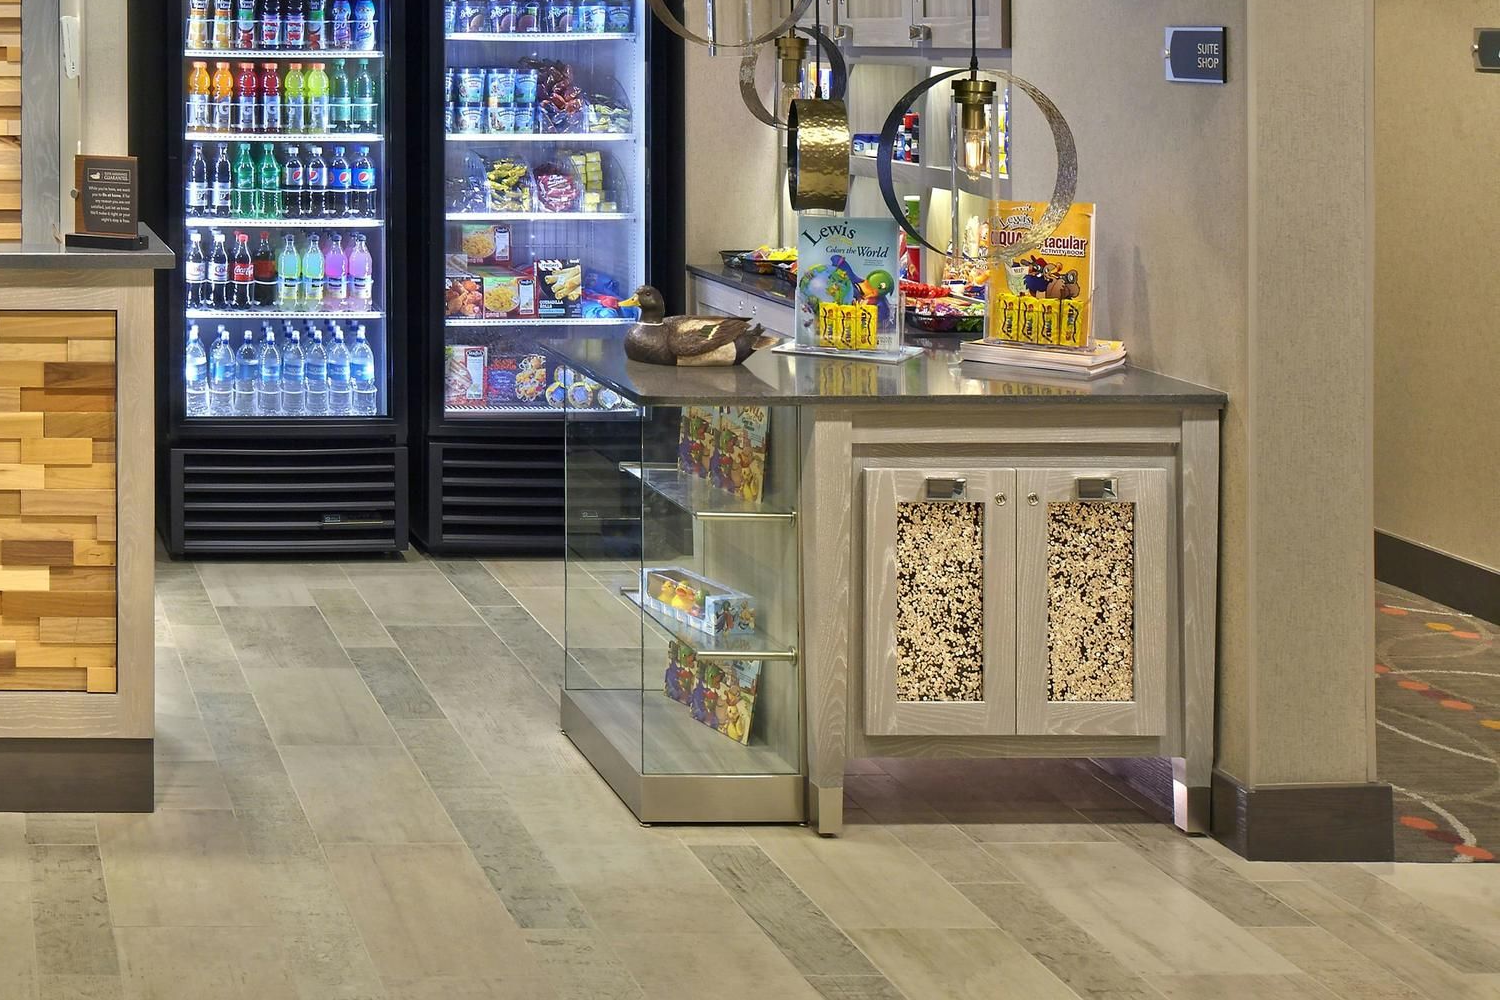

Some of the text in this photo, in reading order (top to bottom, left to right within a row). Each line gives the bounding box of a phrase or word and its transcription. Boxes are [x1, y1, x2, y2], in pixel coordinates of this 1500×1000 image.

[1197, 43, 1219, 54] SUITE
[1197, 57, 1219, 68] SHOP
[999, 214, 1034, 230] Lewis
[801, 221, 856, 246] Lewis
[857, 246, 890, 258] World
